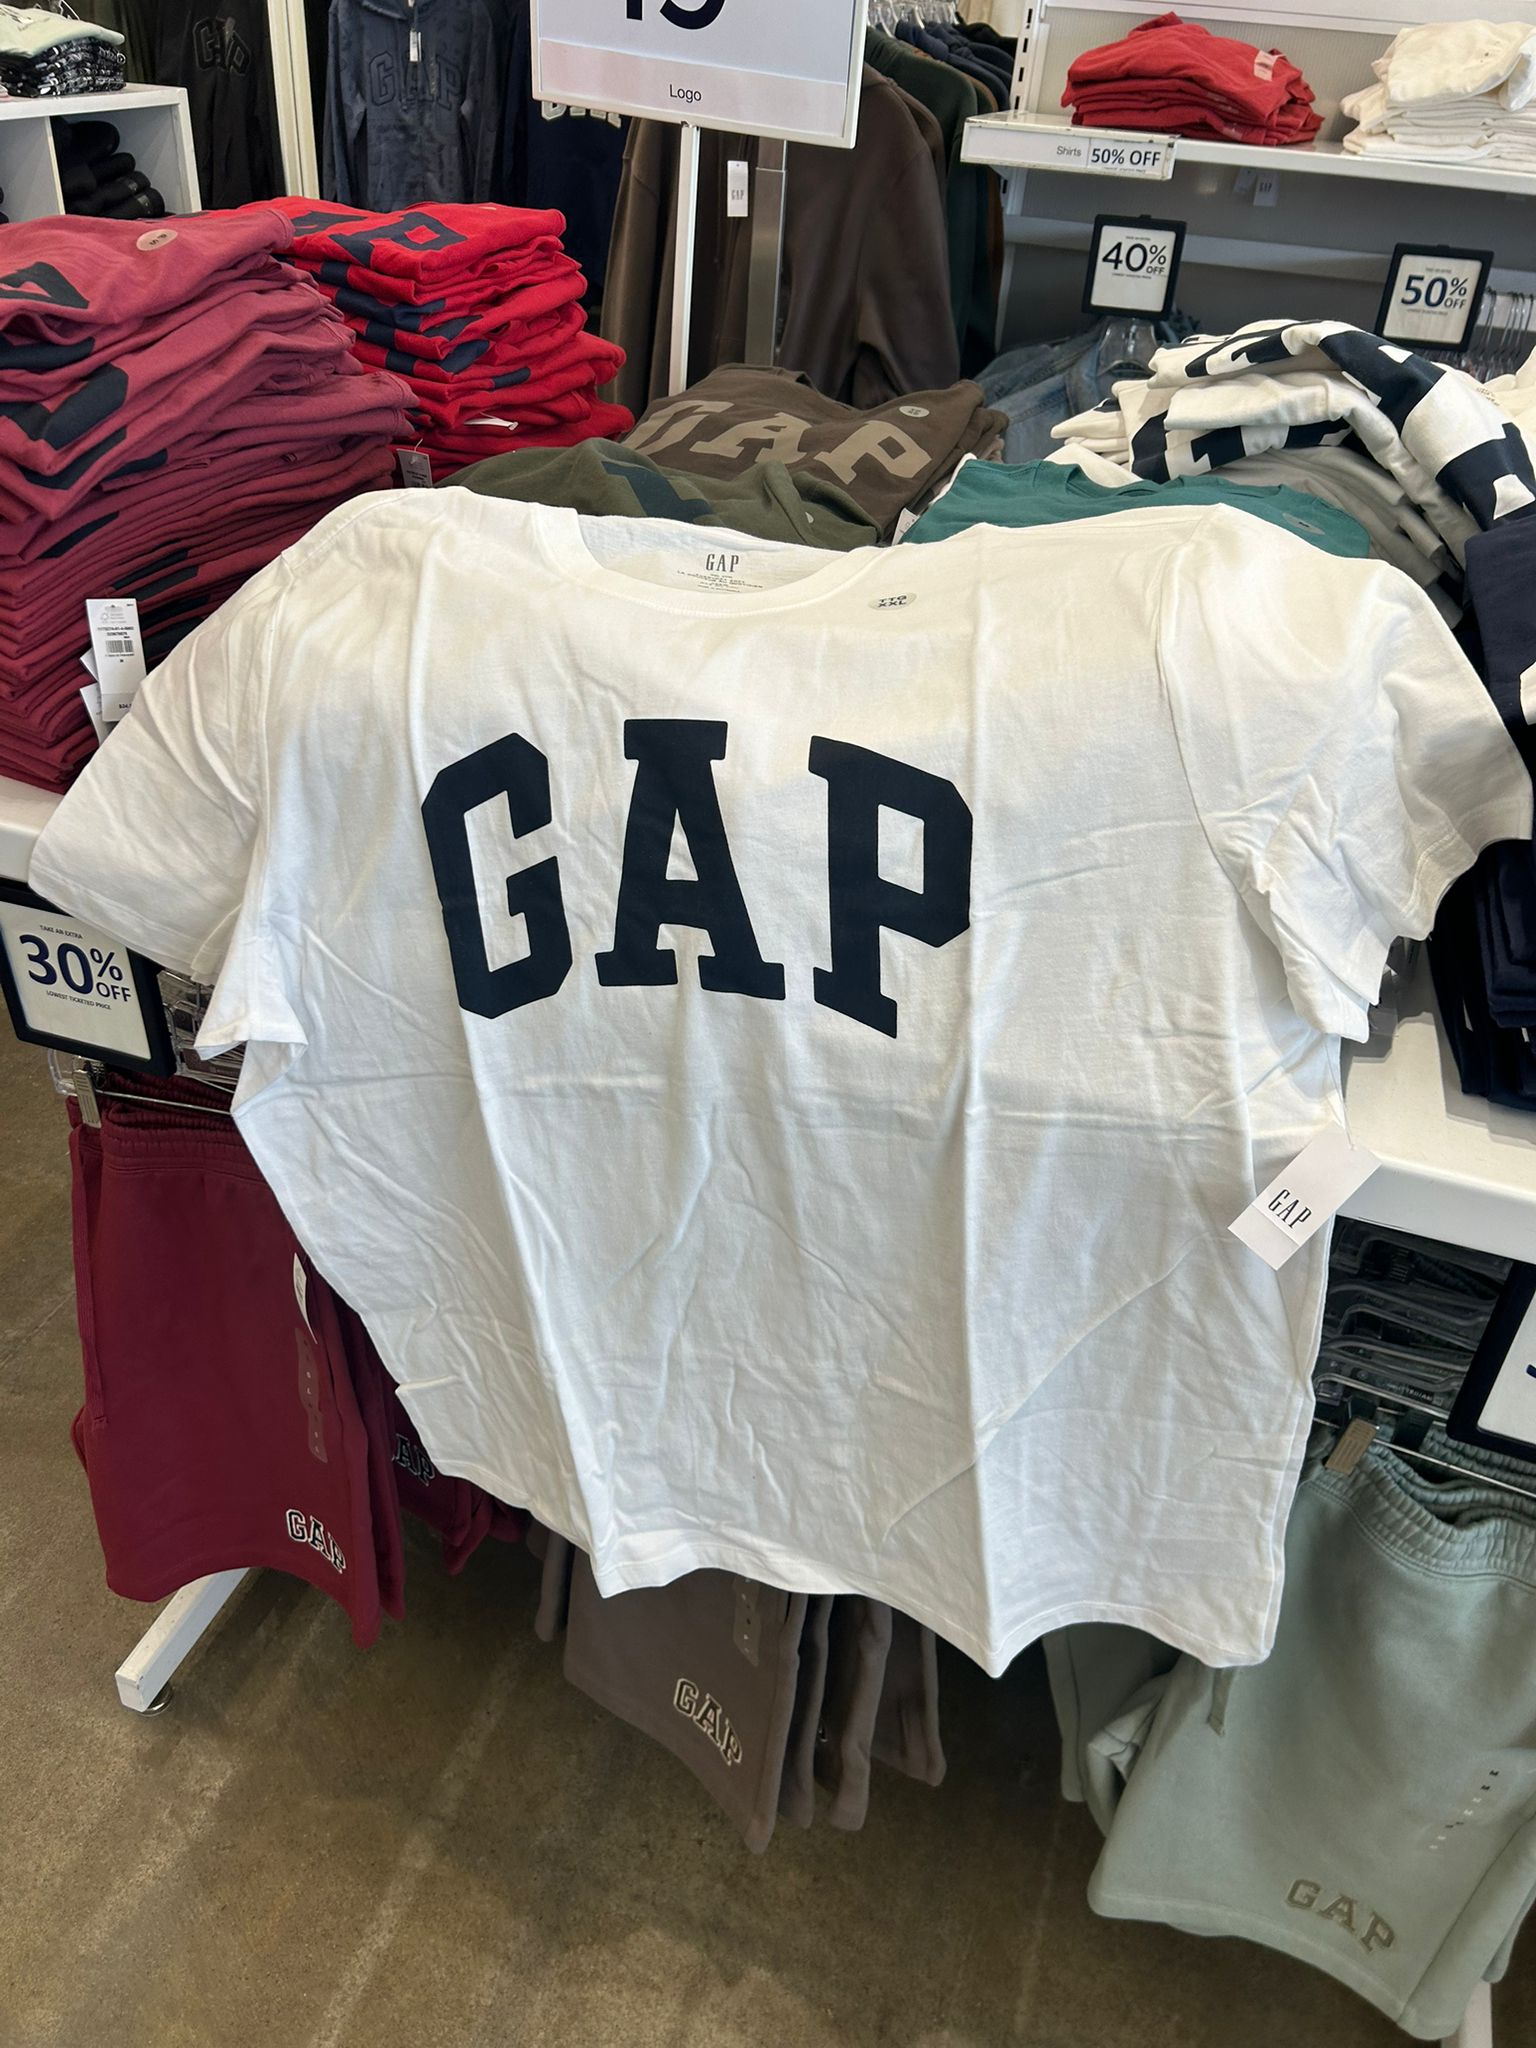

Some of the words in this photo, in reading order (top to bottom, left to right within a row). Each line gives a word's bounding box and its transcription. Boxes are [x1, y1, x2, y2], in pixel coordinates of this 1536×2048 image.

[669, 83, 702, 104] Logo
[1056, 145, 1082, 157] Shirts
[1091, 148, 1125, 165] 50%
[1129, 150, 1161, 166] OFF
[1102, 242, 1167, 272] 40%
[1146, 266, 1165, 275] OFF
[1401, 274, 1469, 307] 50%
[1444, 297, 1466, 309] OFF
[705, 553, 740, 572] GAP
[878, 600, 907, 608] XXL
[421, 719, 973, 1038] GAP
[19, 934, 124, 995] 30%
[46, 990, 68, 1001] LOWEST
[96, 982, 132, 1002] OFF
[1268, 1189, 1312, 1228] GAP
[391, 1433, 435, 1487] AP
[285, 1508, 347, 1575] GAP
[673, 1678, 743, 1767] GAP
[1286, 1879, 1395, 1953] GAP
